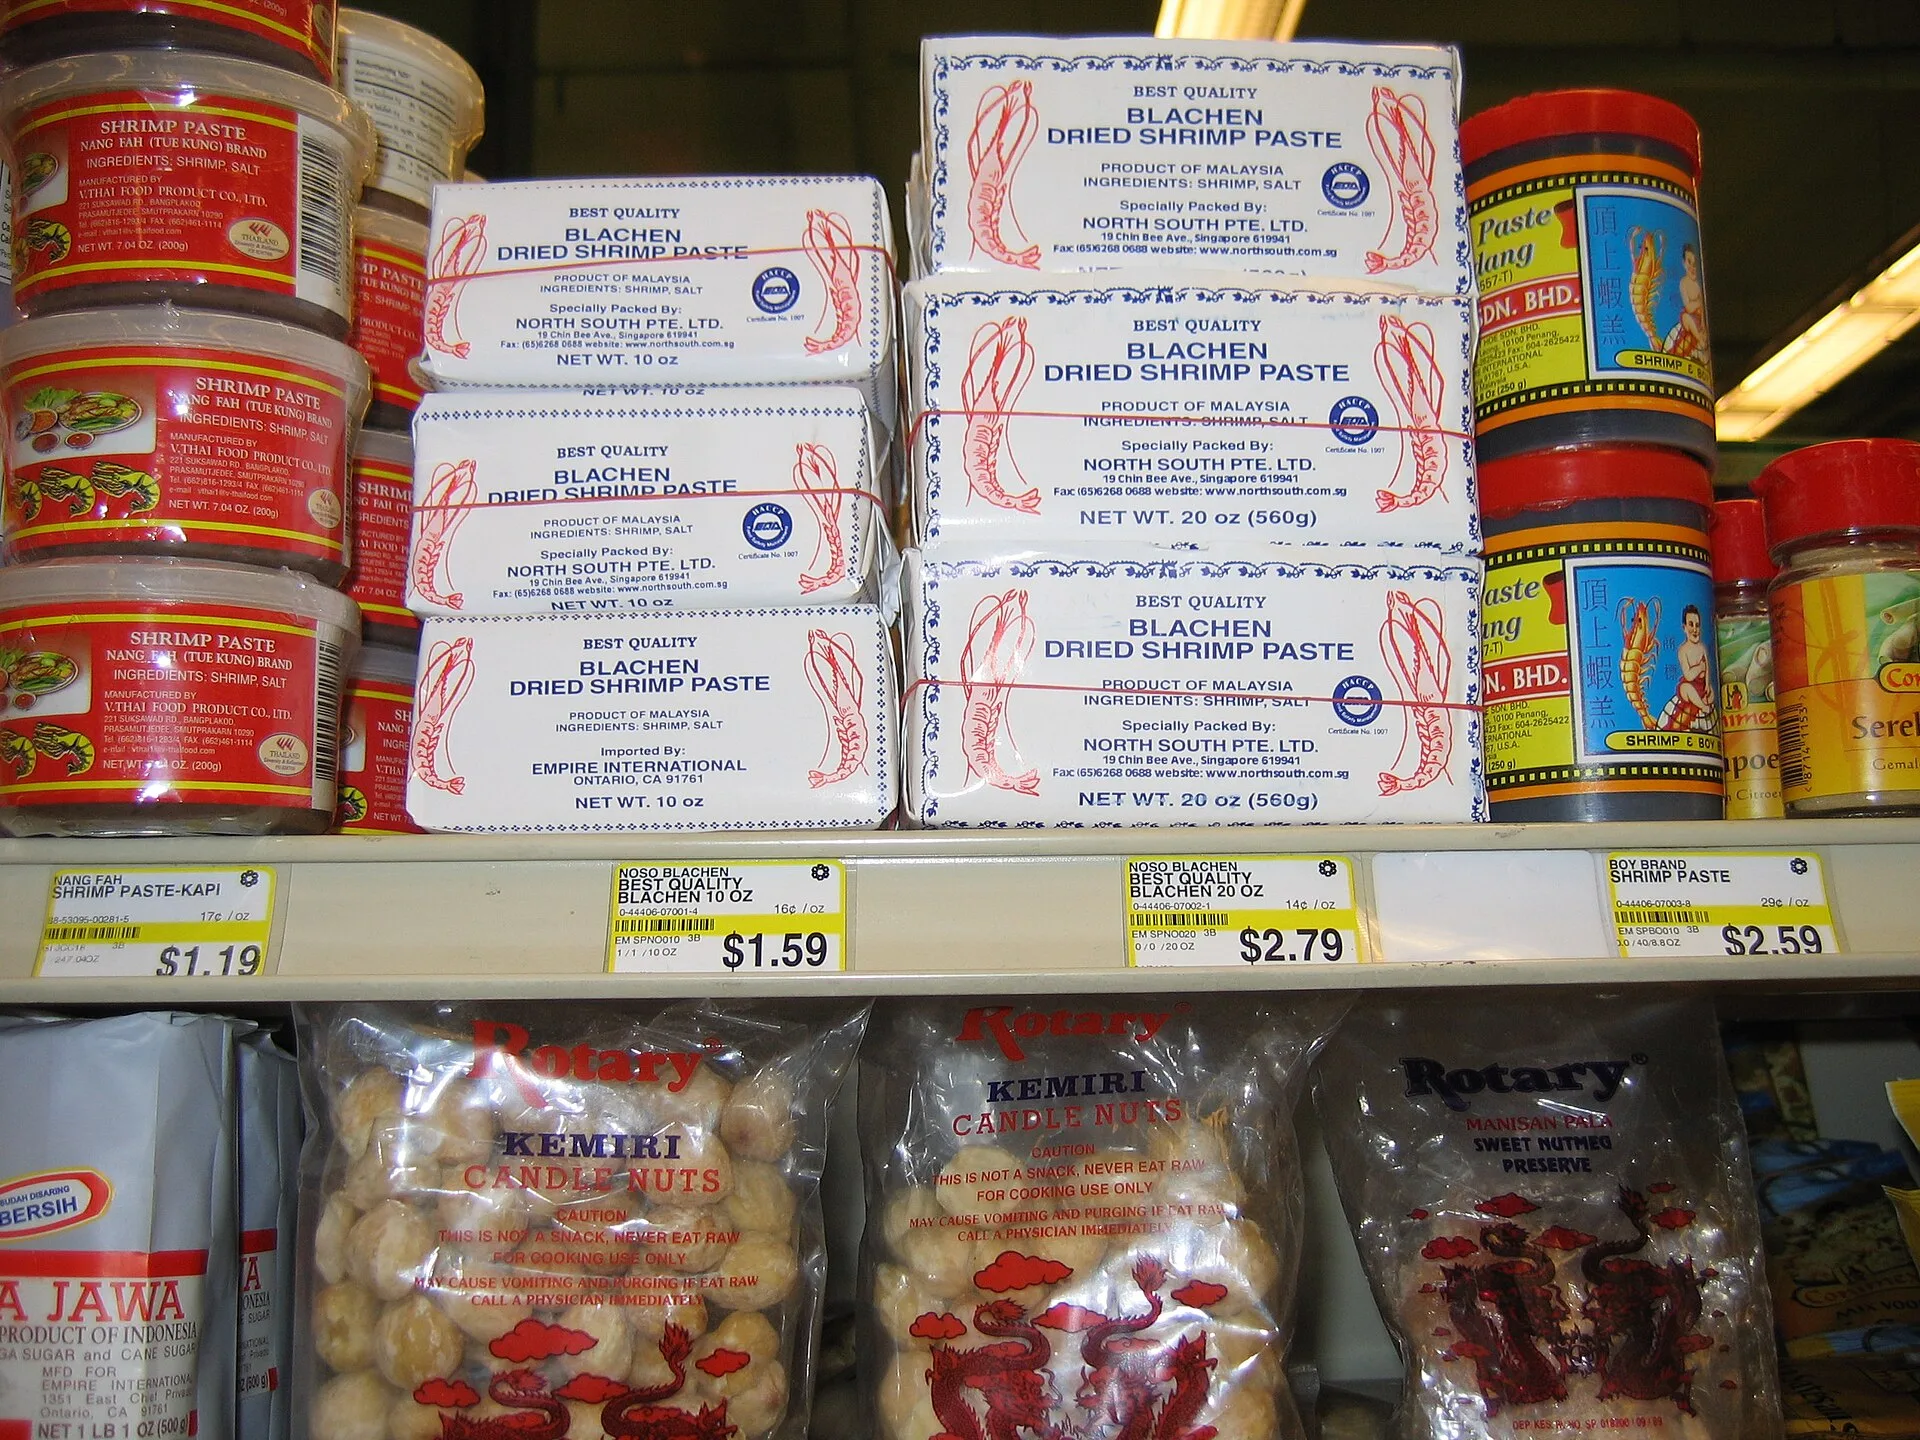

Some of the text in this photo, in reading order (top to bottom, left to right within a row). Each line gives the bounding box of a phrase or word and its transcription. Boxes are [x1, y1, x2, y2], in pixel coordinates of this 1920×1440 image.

[100, 120, 247, 141] SHRIMP PASTE
[1047, 127, 1342, 149] DRIED SHRIMP PASTE
[80, 137, 267, 159] NANG FAH (TUE KUNG) BRAND
[79, 186, 268, 208] V.THAI FOOD PRODUCT CO., LTD.
[569, 207, 680, 221] BEST QUALITY
[565, 228, 681, 243] BLACHEN
[1478, 207, 1552, 248] Paste
[77, 240, 189, 253] NET WT. 7.04 OZ. (200g)
[1524, 285, 1580, 314] BHD.
[549, 304, 682, 316] Specially Packed By:
[516, 317, 723, 330] NORTH SOUTH PTE. LTD.
[538, 331, 699, 343] 19 Chin Bee Ave., Singapore 619941
[500, 340, 736, 351] Fax: (65)6268 0688 website: www.northsouth.com.sg
[557, 353, 678, 366] NET WT. 10 oz
[1634, 354, 1683, 370] SHRIMP
[1135, 595, 1267, 611] BEST QUALITY
[1129, 618, 1271, 638] BLACHEN
[130, 631, 276, 653] SHRIMP PASTE
[583, 636, 698, 651] BEST QUALITY
[1045, 640, 1354, 661] DRIED SHRIMP PASTE
[580, 659, 699, 676] BLACHEN
[1511, 664, 1569, 690] BHD.
[510, 675, 770, 696] DRIED SHRIMP PASTE
[104, 701, 249, 719] V.THAI FOOD PRODUCT
[556, 720, 723, 732] INGREDIENTS: SHRIMP, SALT
[1625, 735, 1716, 749] SHRIMP BOY
[601, 745, 686, 759] Imported By:
[532, 759, 747, 775] EMPIRE INTERNATIONAL
[573, 774, 703, 786] ONTARIO, CA 91761
[575, 796, 704, 809] NET WT. 10 oz
[1079, 792, 1318, 811] NET WT. 20 oz (560g)
[1609, 859, 1687, 870] BOY BRAND
[54, 874, 123, 886] NANG FAH
[619, 867, 729, 879] NOSO BLACHEN
[1610, 870, 1731, 884] SHRIMP PASTE
[52, 883, 221, 899] SHRIMP PASTE-KAPI
[618, 877, 743, 891] BEST QUALITY
[1130, 884, 1264, 898] BLACHEN 20 OZ
[618, 889, 753, 904] BLACHEN 10 OZ
[1615, 899, 1692, 909] 0-44406-07003-8
[619, 907, 698, 917] 0-44406-07001-4
[774, 904, 797, 915] 16¢
[1132, 901, 1210, 911] 0-44406-07002-1
[1286, 899, 1308, 911] 14¢
[1239, 925, 1343, 966] $2.79
[1722, 923, 1823, 955] $2.59
[722, 930, 827, 973] $1.59
[156, 945, 262, 977] $1.19
[955, 1004, 1172, 1062] Rotary
[466, 1020, 702, 1109] Rotary
[986, 1069, 1149, 1103] KEMIRI
[1400, 1057, 1630, 1113] Rotary
[952, 1098, 1184, 1137] CANDLE NUTS
[1466, 1114, 1614, 1132] MANISAN PALA
[502, 1132, 681, 1160] KEMIRI
[1474, 1134, 1613, 1153] SWEET NUTMEG
[1502, 1156, 1593, 1175] PRESERVE
[464, 1164, 721, 1193] CANDLE NUTS
[977, 1181, 1153, 1202] FOR COOKING USE ONLY
[0, 1196, 79, 1228] BERSIH
[556, 1208, 628, 1223] CAUTION
[493, 1252, 687, 1266] FOR COOKING USE ONLY
[47, 1279, 186, 1323] JAWA
[0, 1322, 199, 1345] PRODUCT OF INDONESIA
